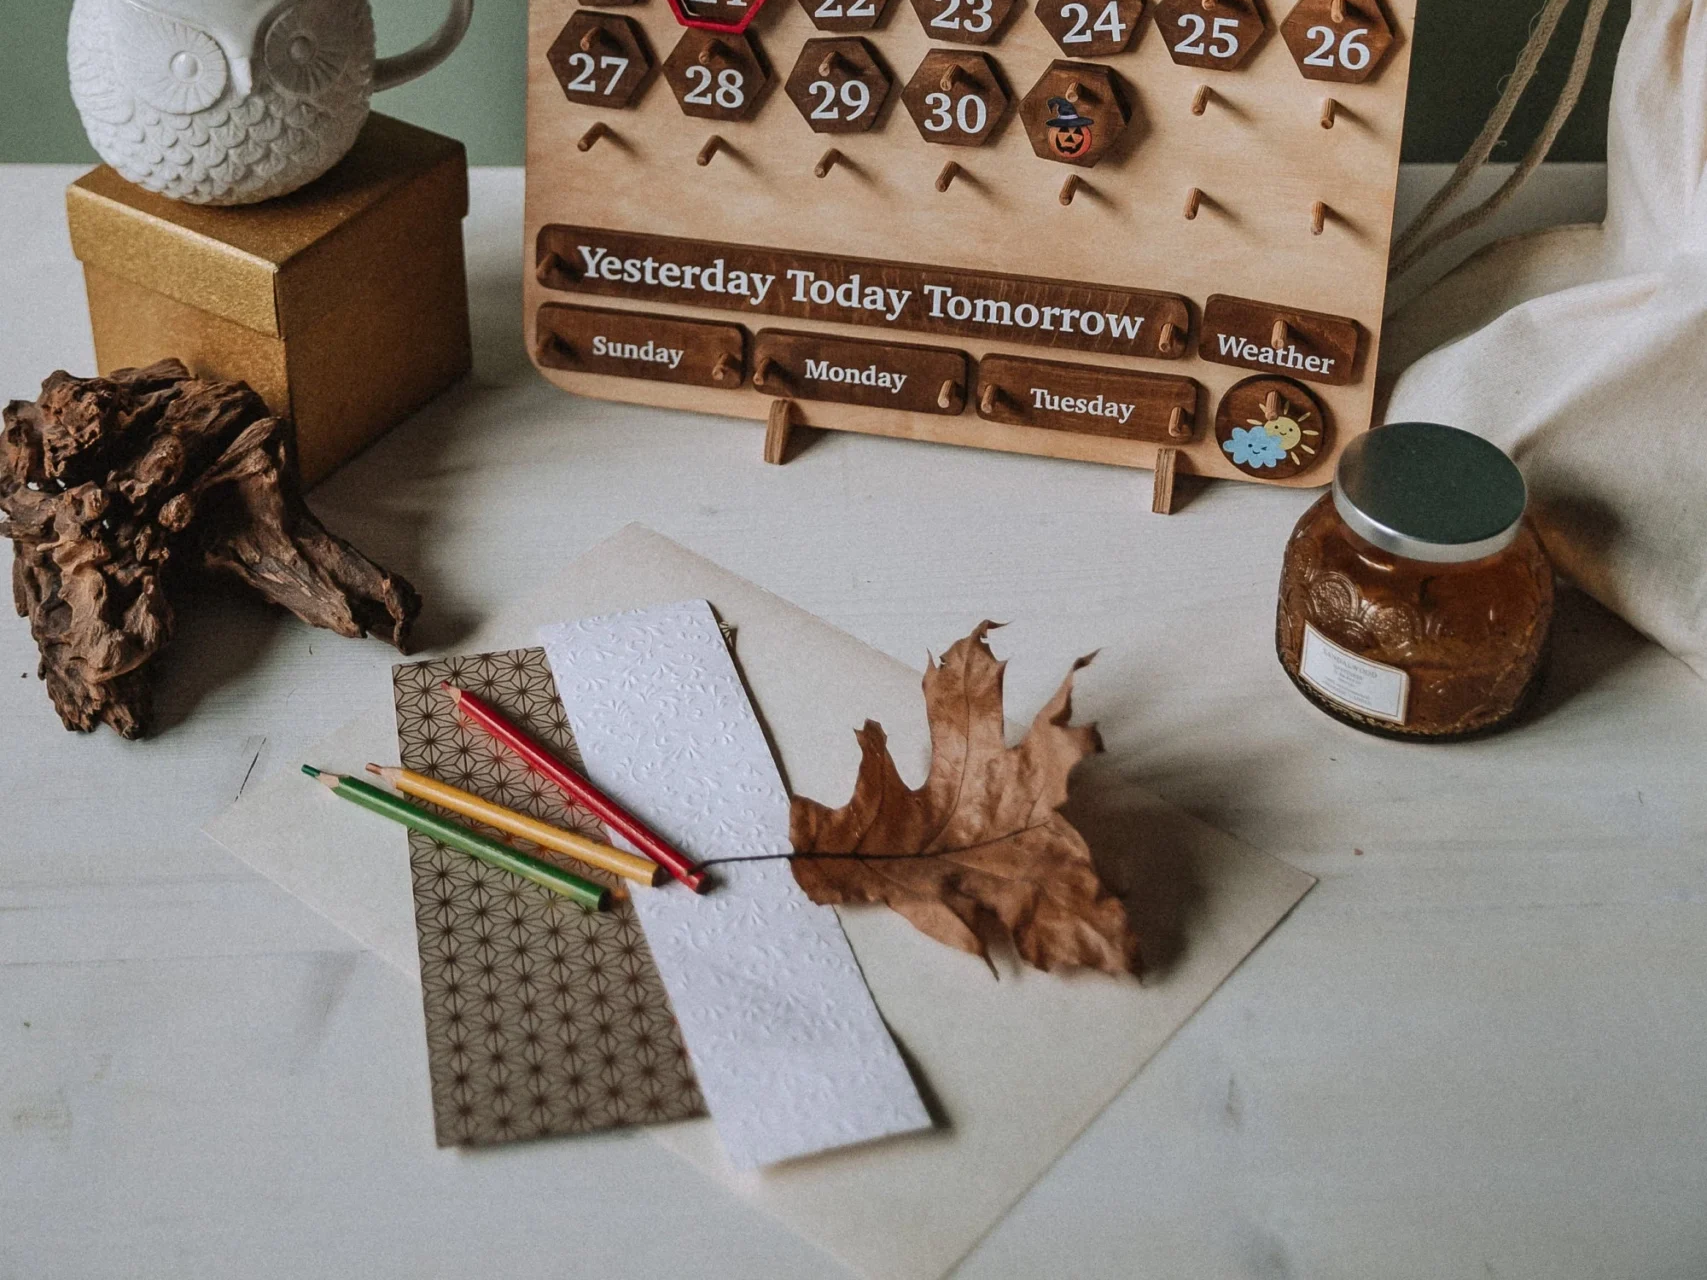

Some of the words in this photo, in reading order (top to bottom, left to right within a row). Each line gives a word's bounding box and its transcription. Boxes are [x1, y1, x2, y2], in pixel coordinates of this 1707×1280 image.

[1061, 1, 1126, 43] 24
[1175, 14, 1238, 57] 25
[1304, 26, 1370, 69] 26
[568, 53, 628, 95] 27
[684, 66, 744, 108] 28
[809, 80, 869, 120] 29
[924, 93, 986, 133] 30
[577, 246, 775, 305] Yesterday
[787, 270, 912, 320] Today
[924, 285, 1144, 339] Tomorrow
[593, 336, 684, 369] Sunday
[1217, 333, 1334, 375] Weather
[805, 359, 907, 393] Monday
[1031, 388, 1135, 423] Tuesday
